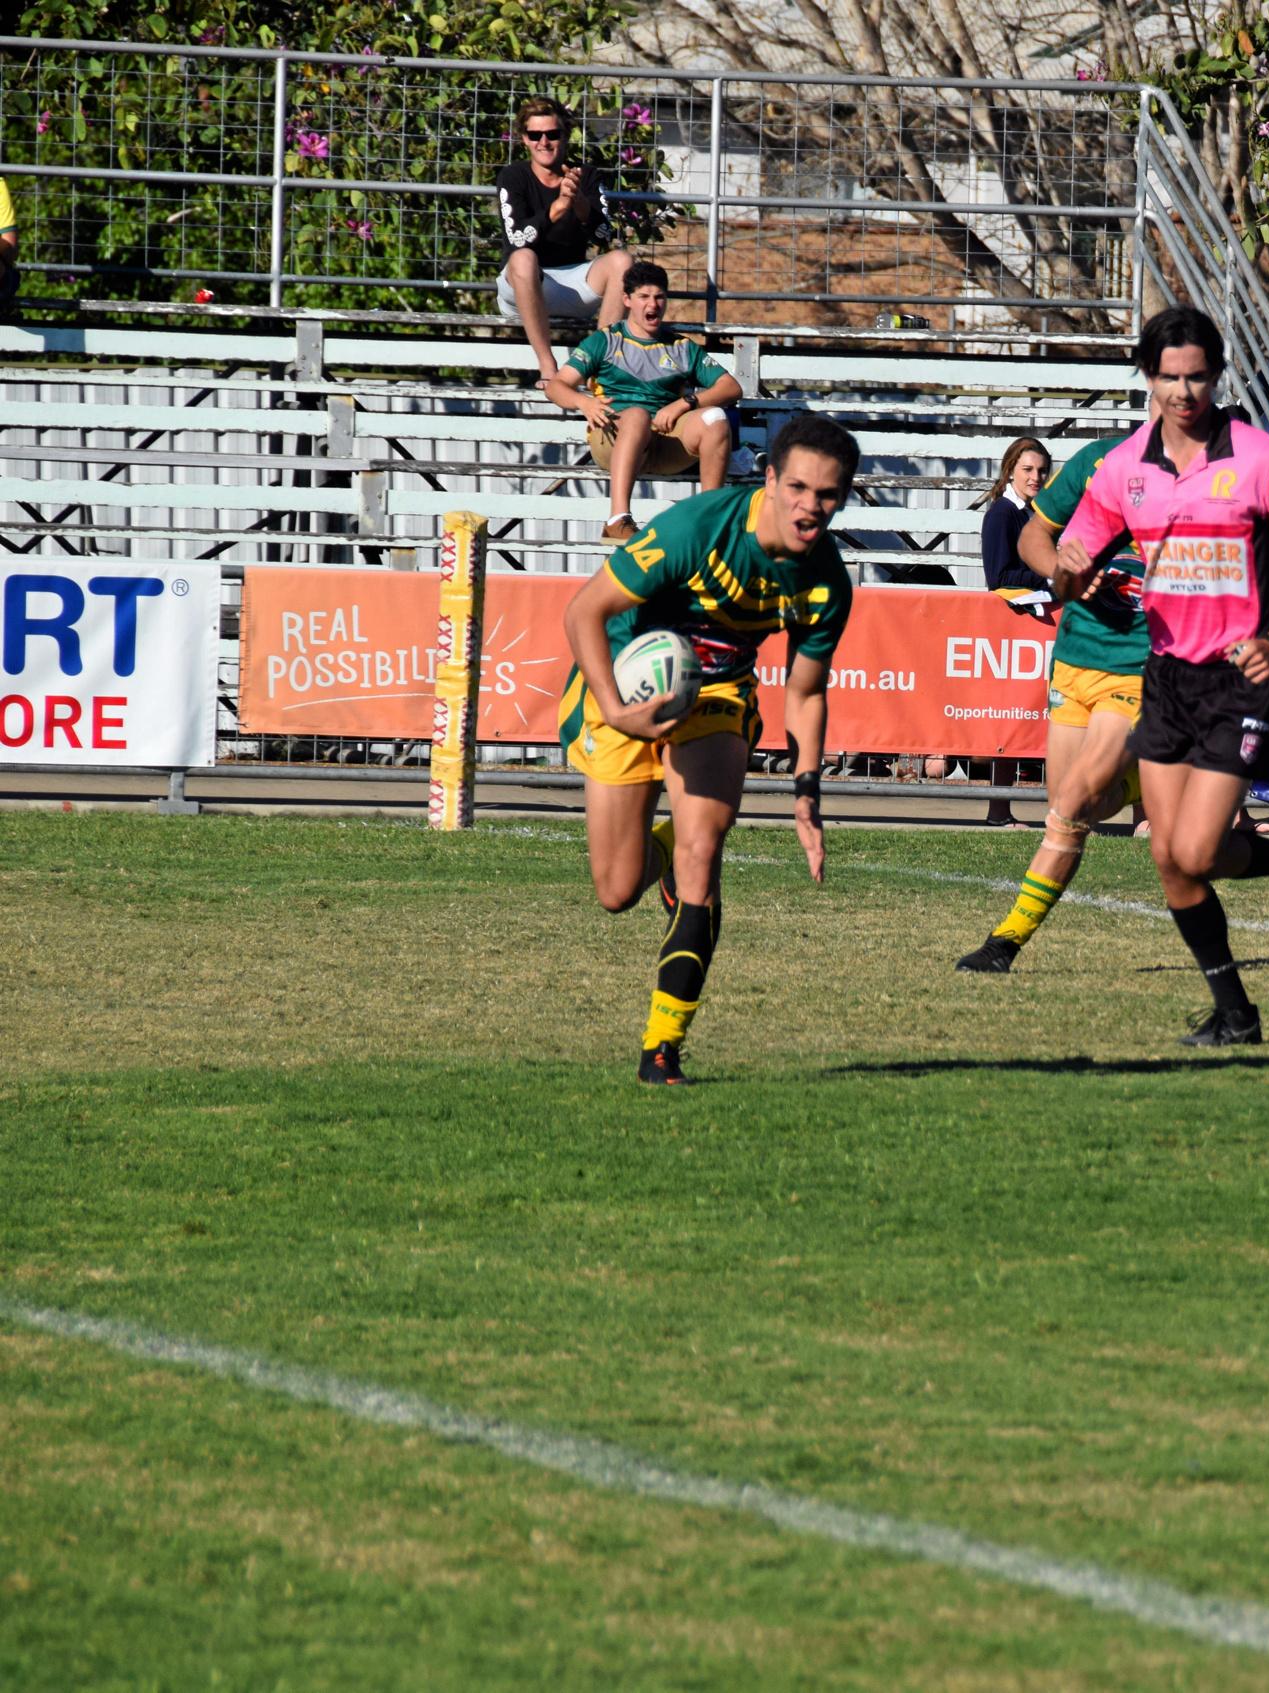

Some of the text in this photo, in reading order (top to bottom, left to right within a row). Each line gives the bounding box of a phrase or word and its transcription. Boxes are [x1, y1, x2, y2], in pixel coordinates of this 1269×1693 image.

[625, 530, 666, 574] 14
[281, 604, 369, 653] REAL
[943, 703, 1051, 720] Opportunities f
